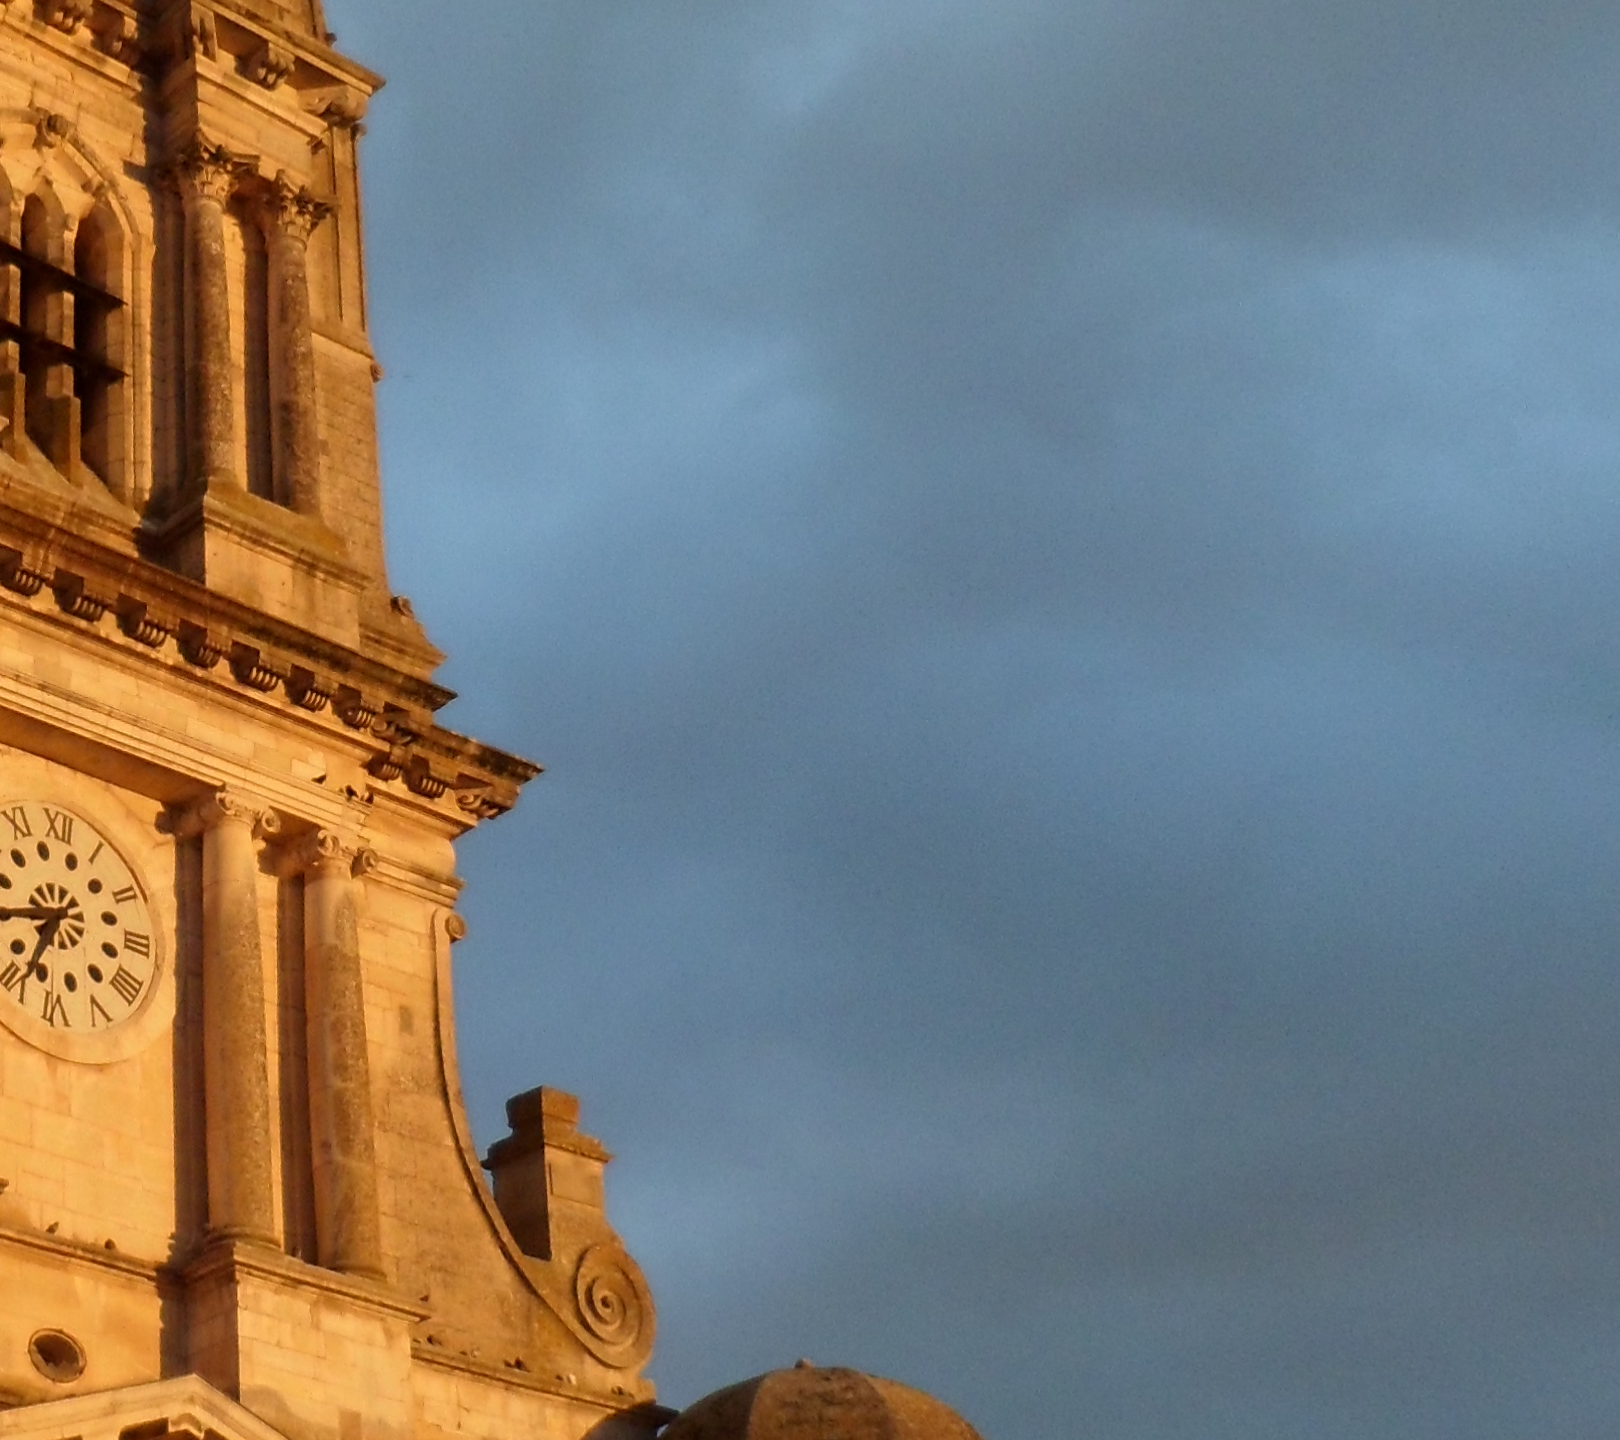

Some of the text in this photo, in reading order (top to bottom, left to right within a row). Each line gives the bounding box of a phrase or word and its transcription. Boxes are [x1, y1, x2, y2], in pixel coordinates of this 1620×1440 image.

[1, 806, 33, 839] XI
[43, 807, 73, 845] XII
[88, 840, 104, 864] I
[112, 884, 137, 904] II
[124, 929, 150, 959] III
[109, 964, 144, 1006] IIII
[41, 990, 70, 1027] VI
[89, 994, 113, 1027] V
